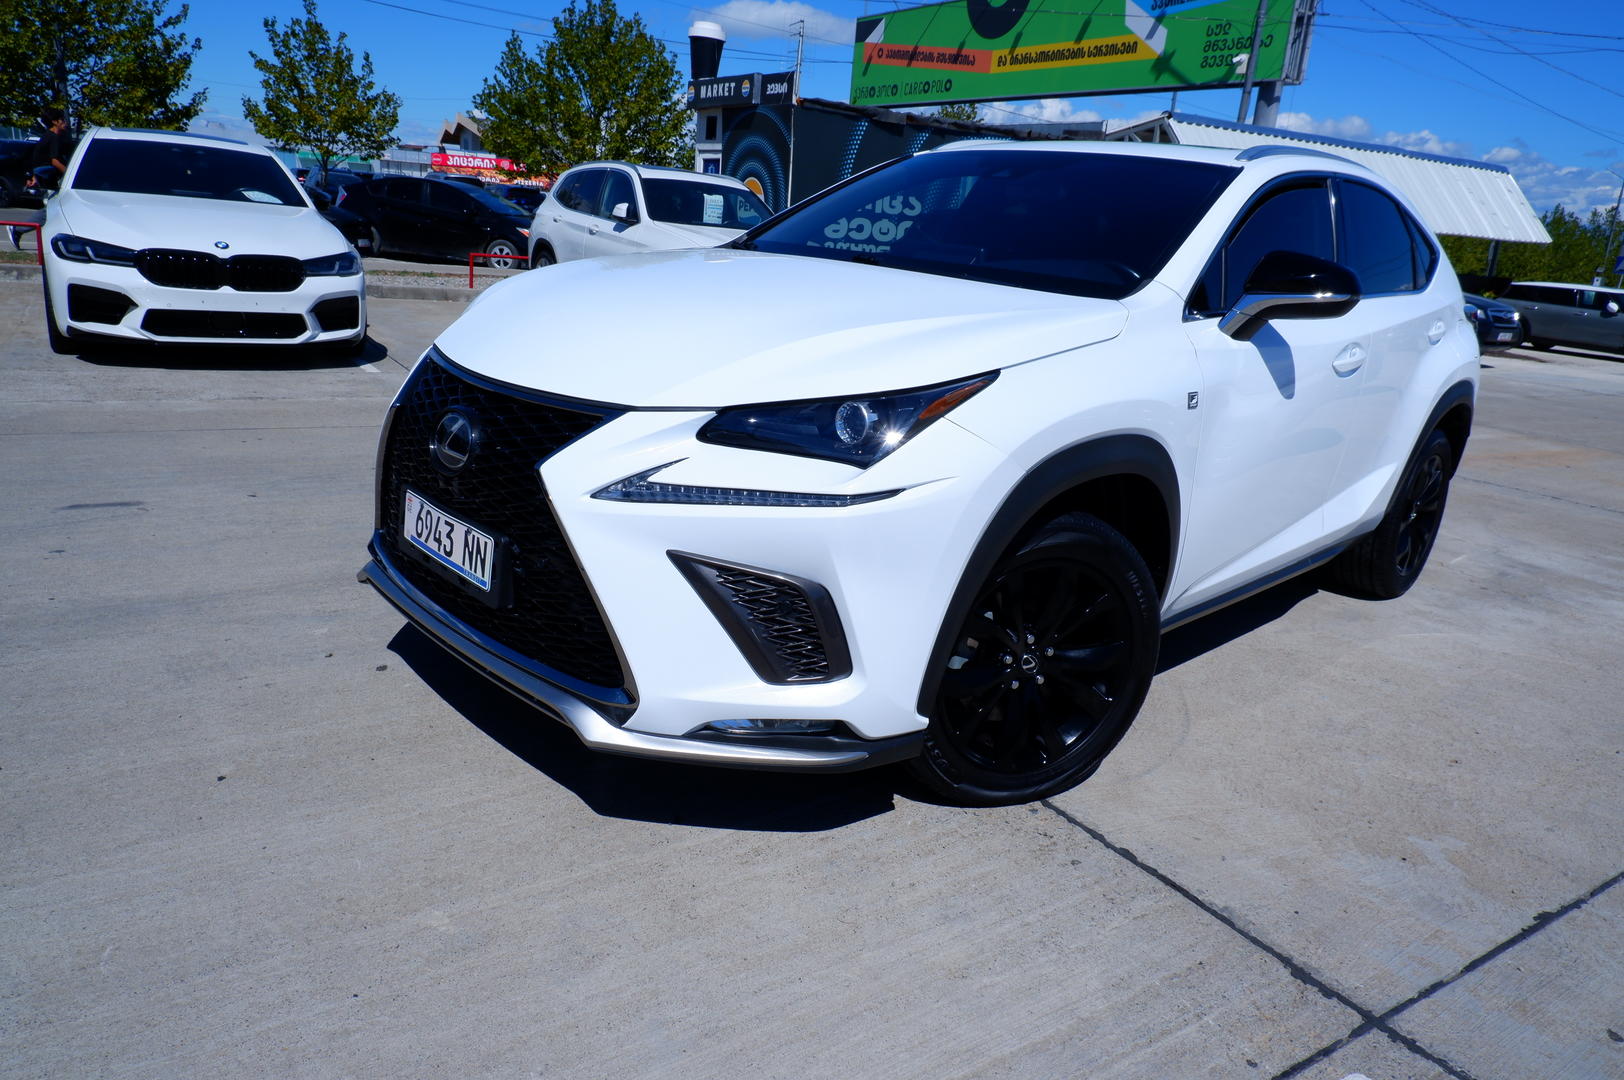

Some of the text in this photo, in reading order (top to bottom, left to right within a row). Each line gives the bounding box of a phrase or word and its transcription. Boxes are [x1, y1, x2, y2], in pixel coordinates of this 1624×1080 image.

[1087, 41, 1138, 58] სერვისები
[1203, 34, 1274, 53] მწვანეე
[700, 82, 736, 99] MARKET
[416, 501, 488, 579] 6943 NN
